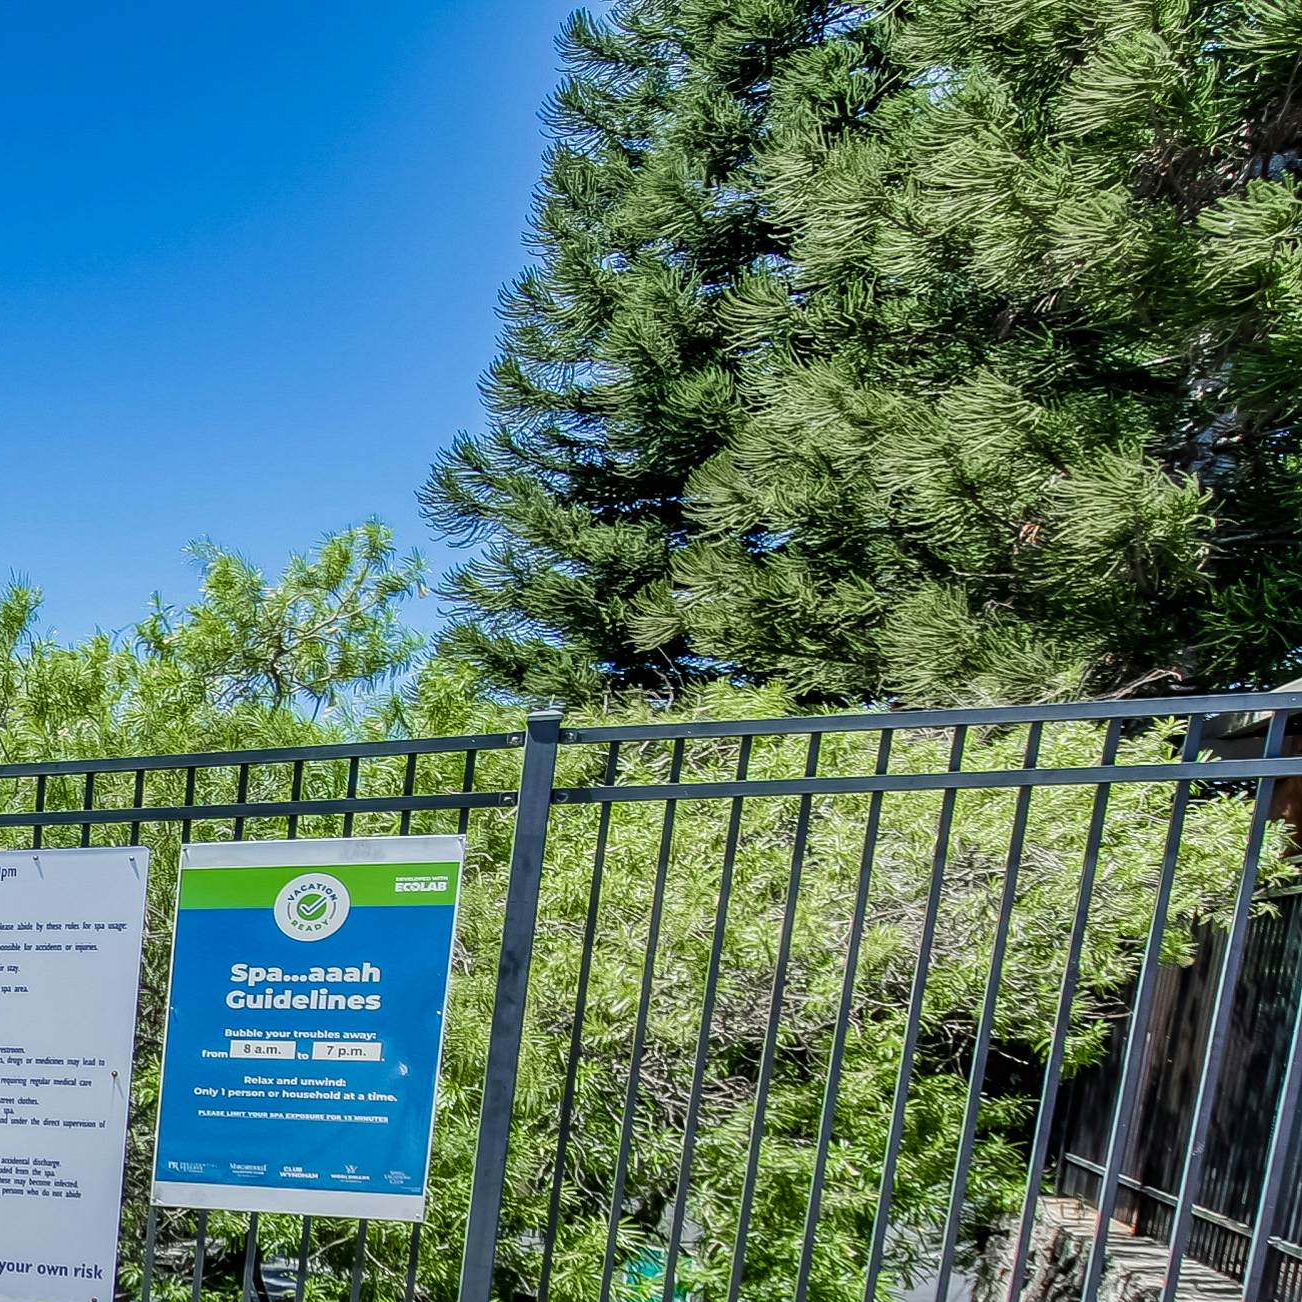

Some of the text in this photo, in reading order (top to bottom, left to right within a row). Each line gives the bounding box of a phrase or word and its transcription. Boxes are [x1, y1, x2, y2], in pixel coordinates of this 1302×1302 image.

[287, 883, 338, 902] VACATION
[395, 882, 447, 892] ECOLAB
[291, 919, 329, 931] READY
[230, 963, 381, 987] Spa...aaah
[226, 989, 381, 1010] Guidelines
[224, 1028, 377, 1041] Bubble your troubles away:
[201, 1043, 367, 1060] from 8 a.m. to 7 p.m.
[244, 1076, 347, 1087] Relax and unwind:
[193, 1087, 219, 1098] Only
[220, 1088, 226, 1096] 1
[228, 1089, 266, 1098] person
[282, 1089, 341, 1100] household
[343, 1092, 356, 1100] at
[367, 1092, 398, 1102] time.
[198, 1109, 226, 1117] PLEASE
[37, 1263, 68, 1277] own
[73, 1263, 103, 1280] risk
